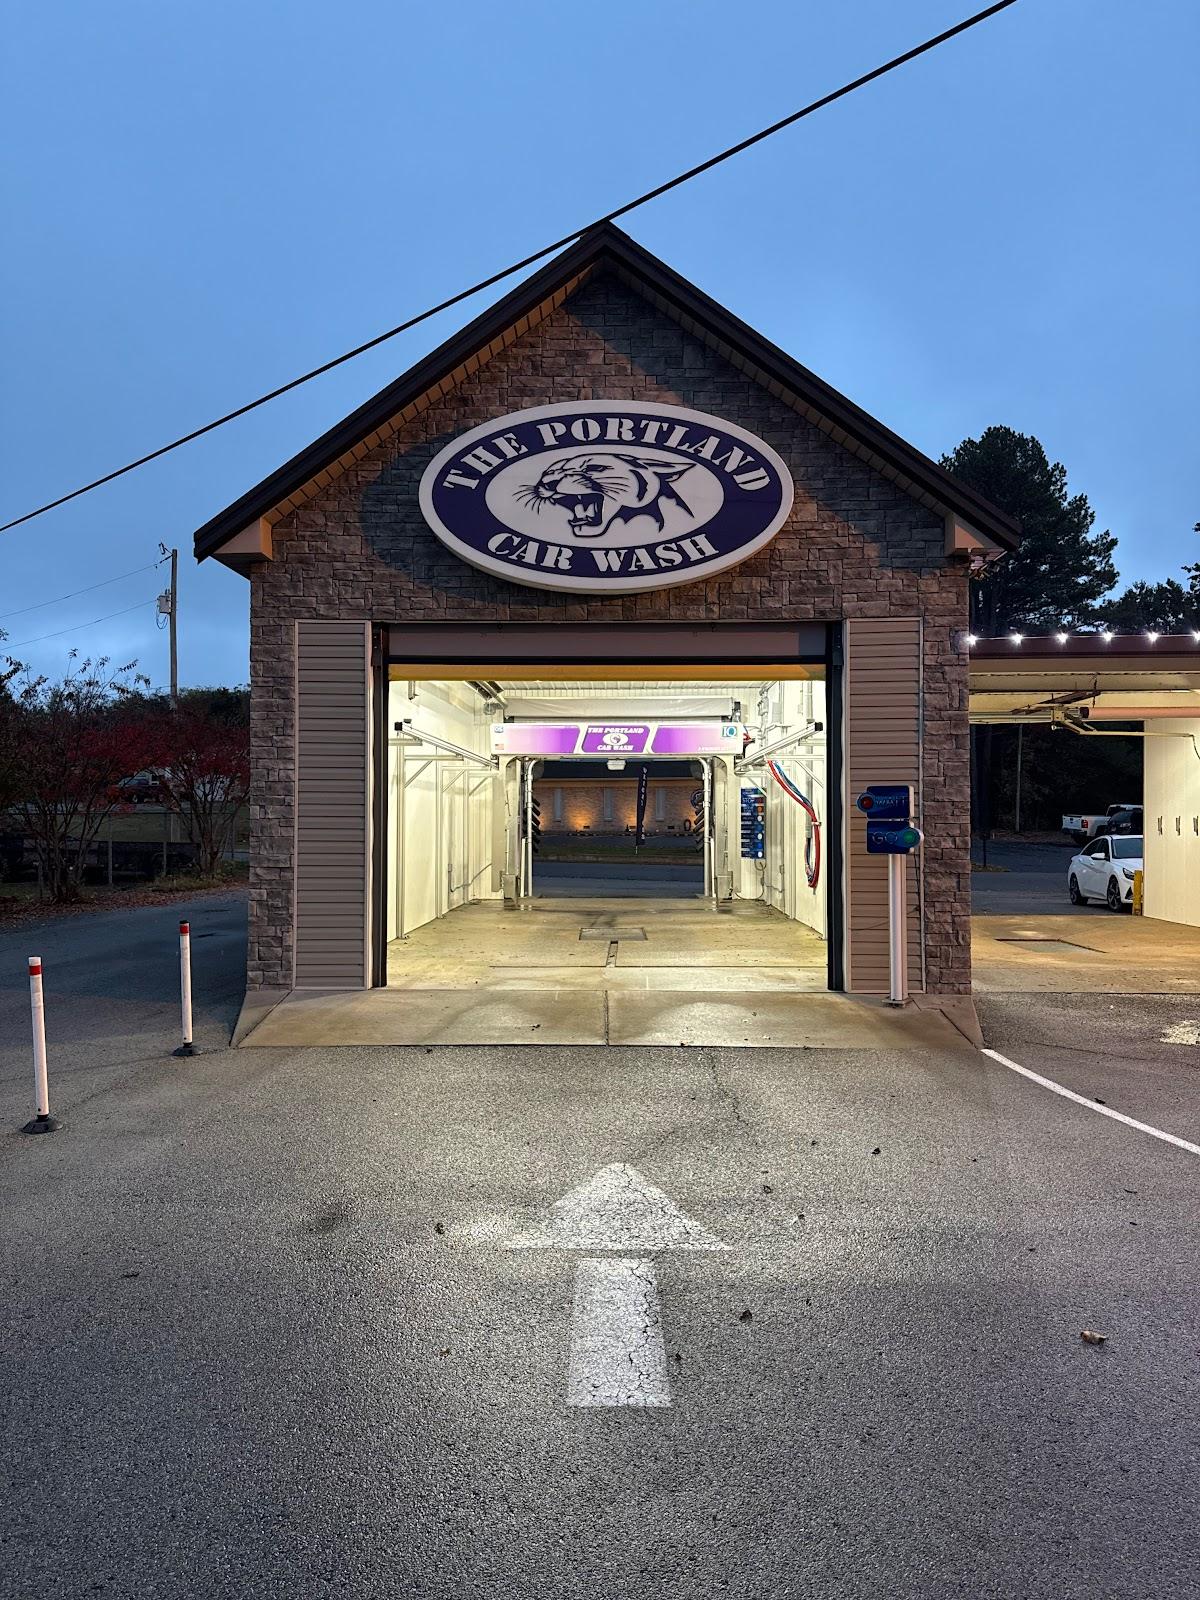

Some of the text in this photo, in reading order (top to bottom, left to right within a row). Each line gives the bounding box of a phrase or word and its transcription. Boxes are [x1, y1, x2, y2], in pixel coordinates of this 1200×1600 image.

[442, 417, 771, 491] THE PORTLAND
[487, 532, 720, 573] CAR WASH
[872, 831, 898, 845] GO
